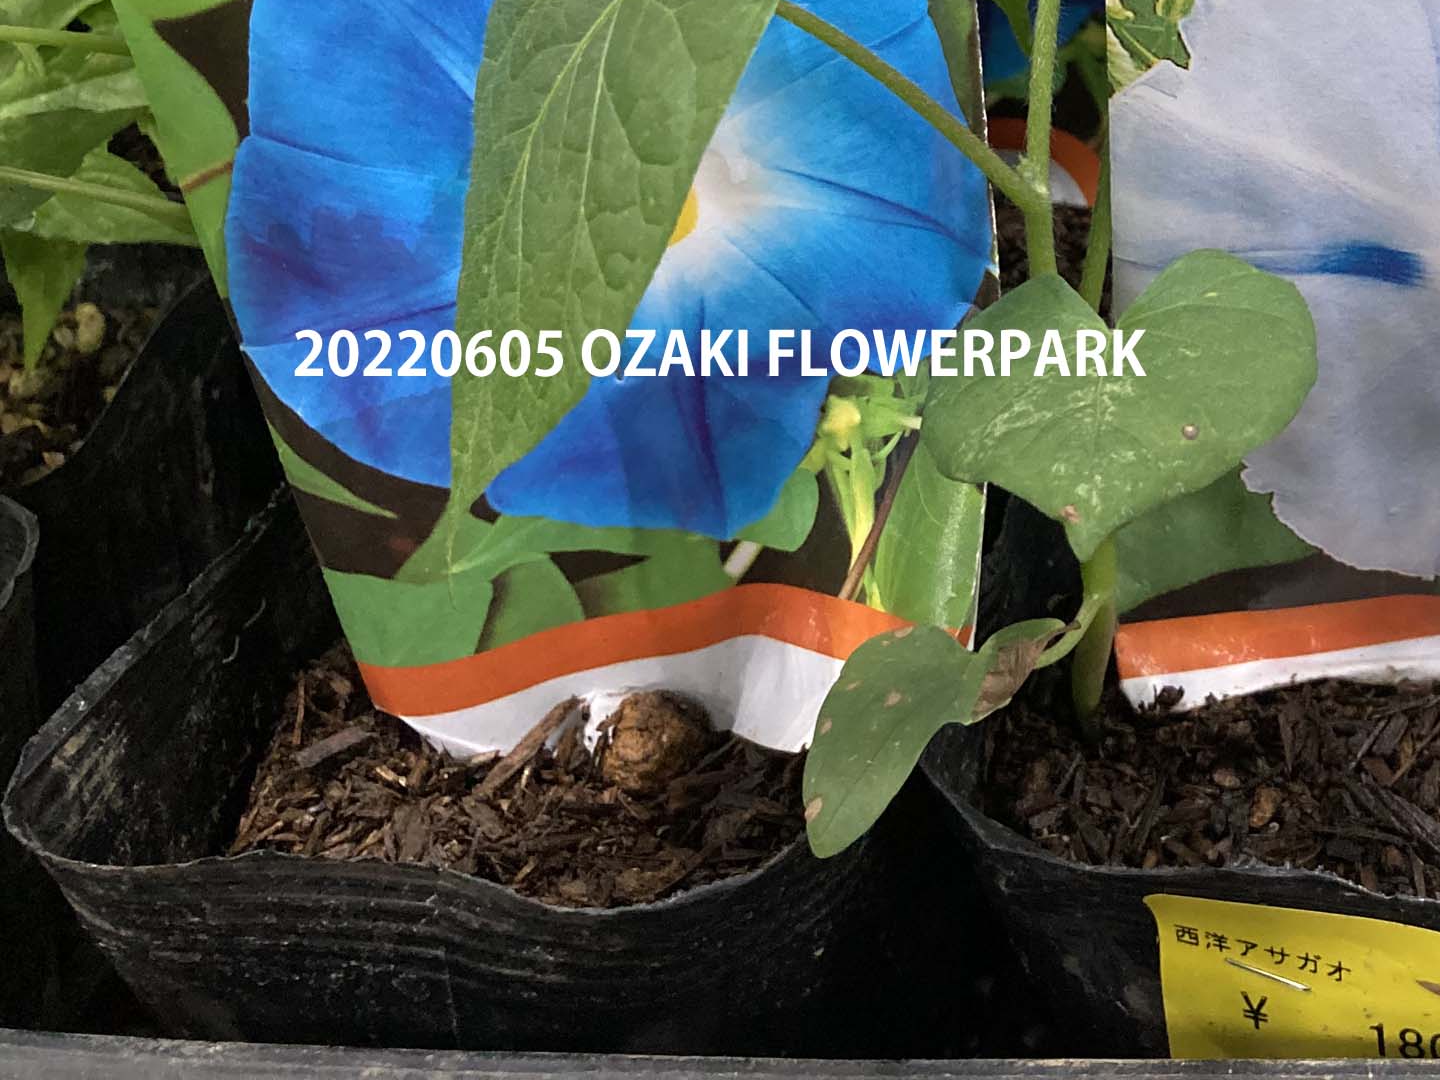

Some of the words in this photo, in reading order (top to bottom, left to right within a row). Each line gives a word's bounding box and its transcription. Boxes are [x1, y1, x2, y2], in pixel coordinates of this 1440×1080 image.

[1173, 923, 1353, 982] 西洋アサガオ
